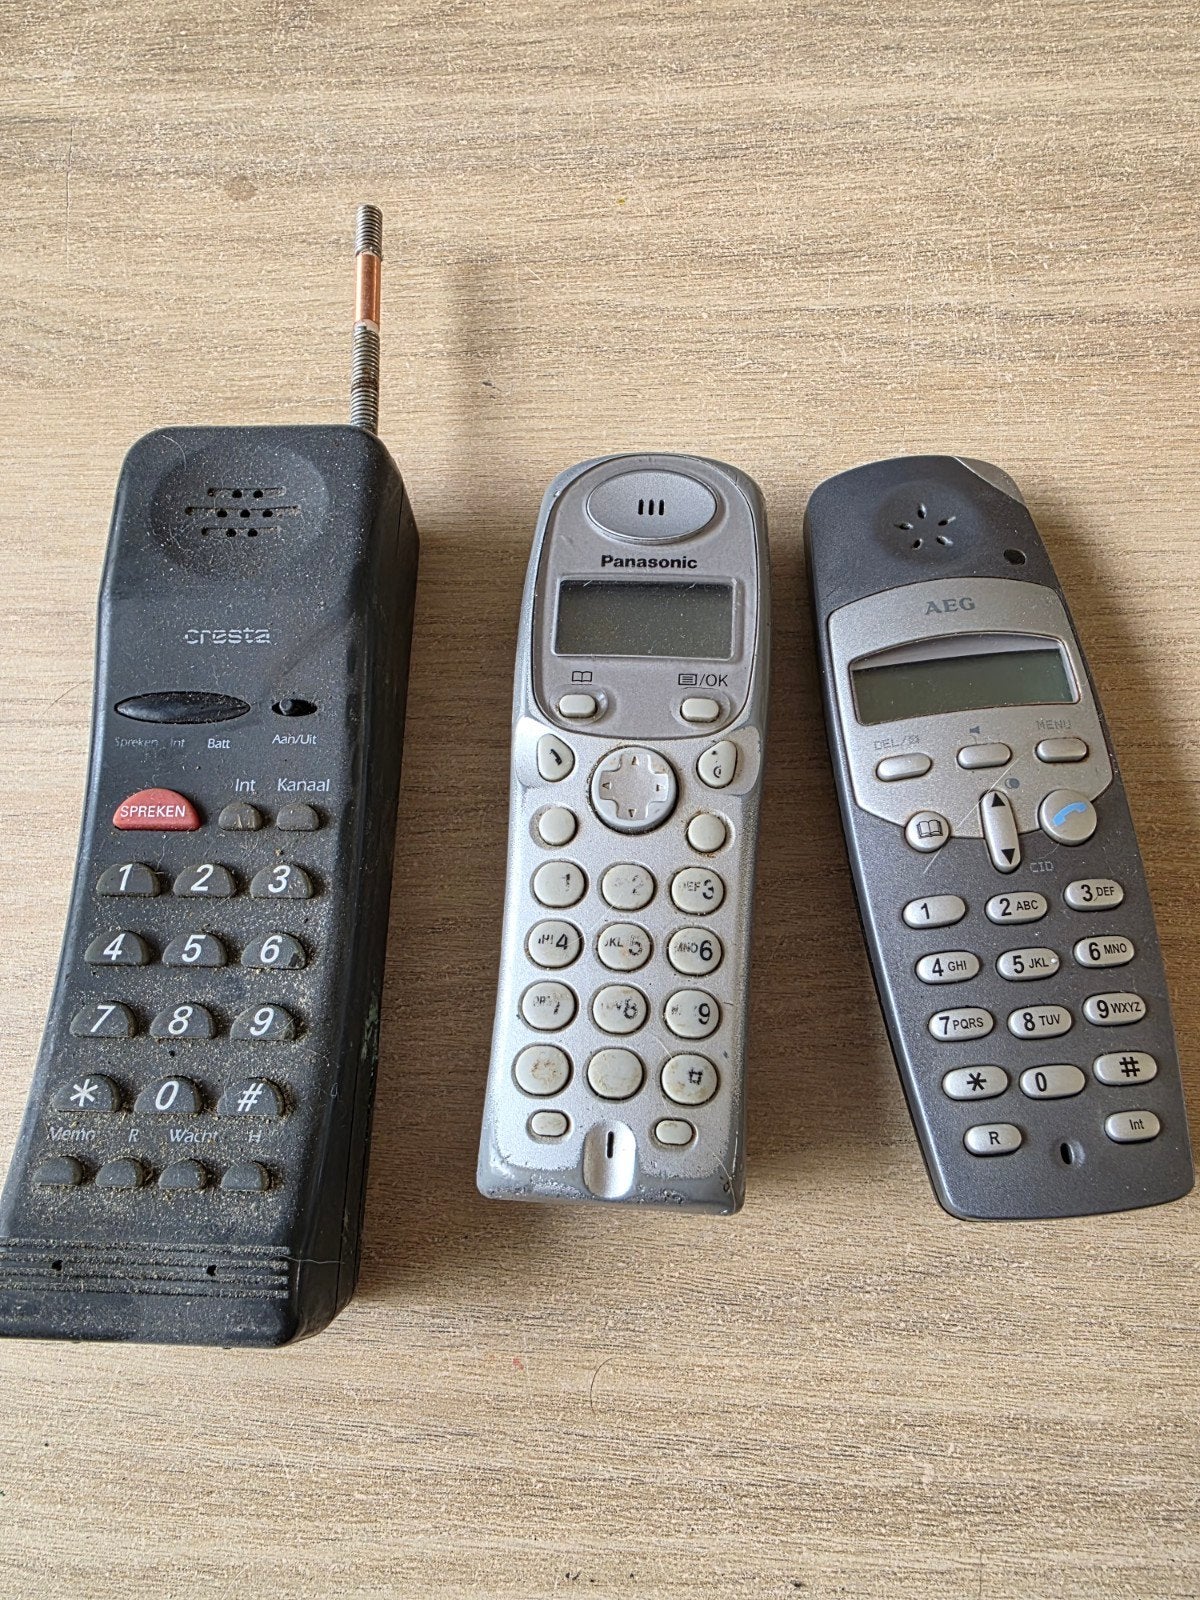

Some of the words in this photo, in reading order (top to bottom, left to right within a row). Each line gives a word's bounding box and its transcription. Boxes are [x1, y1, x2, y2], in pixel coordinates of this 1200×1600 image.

[601, 554, 698, 569] Panasonic
[925, 597, 976, 615] AEG
[1036, 720, 1072, 731] MENU
[207, 738, 231, 749] Batt
[272, 734, 317, 745] Aan/Uit
[235, 778, 256, 792] Int
[277, 778, 330, 792] Kanaal
[120, 805, 186, 818] SPREKEN
[1030, 861, 1053, 873] CID
[118, 863, 133, 891] 1
[190, 864, 214, 892] 2
[268, 864, 291, 893] 3
[702, 879, 714, 900] 3
[1081, 884, 1094, 902] 3
[1096, 886, 1115, 897] DEF
[920, 903, 930, 920] 1
[999, 898, 1012, 917] 2
[1016, 900, 1039, 912] ABC
[103, 933, 126, 961] 4
[181, 934, 206, 963] 5
[260, 935, 282, 963] 6
[556, 933, 568, 950] 4
[700, 940, 713, 961] 6
[1089, 942, 1100, 960] 6
[1104, 943, 1127, 954] MNO
[932, 958, 944, 977] 4
[948, 960, 967, 972] GHI
[1013, 955, 1025, 974] 5
[1029, 957, 1049, 969] JKL
[90, 1005, 116, 1033] 7
[699, 1003, 711, 1025] 9
[1097, 1000, 1109, 1019] 9
[1110, 1002, 1142, 1014] WXYZ
[168, 1005, 193, 1035] 8
[250, 1007, 274, 1036] 9
[939, 1016, 950, 1035] 7
[953, 1017, 984, 1030] PQRS
[1023, 1012, 1035, 1031] 8
[1038, 1014, 1060, 1026] TUV
[1119, 1056, 1140, 1077] #
[1035, 1072, 1047, 1092] 0
[155, 1080, 179, 1111] 0
[237, 1083, 264, 1112] #
[48, 1127, 96, 1142] Memo
[1129, 1119, 1145, 1131] Int
[128, 1128, 140, 1142] R
[169, 1129, 219, 1143] Wacht
[988, 1131, 1000, 1145] R
